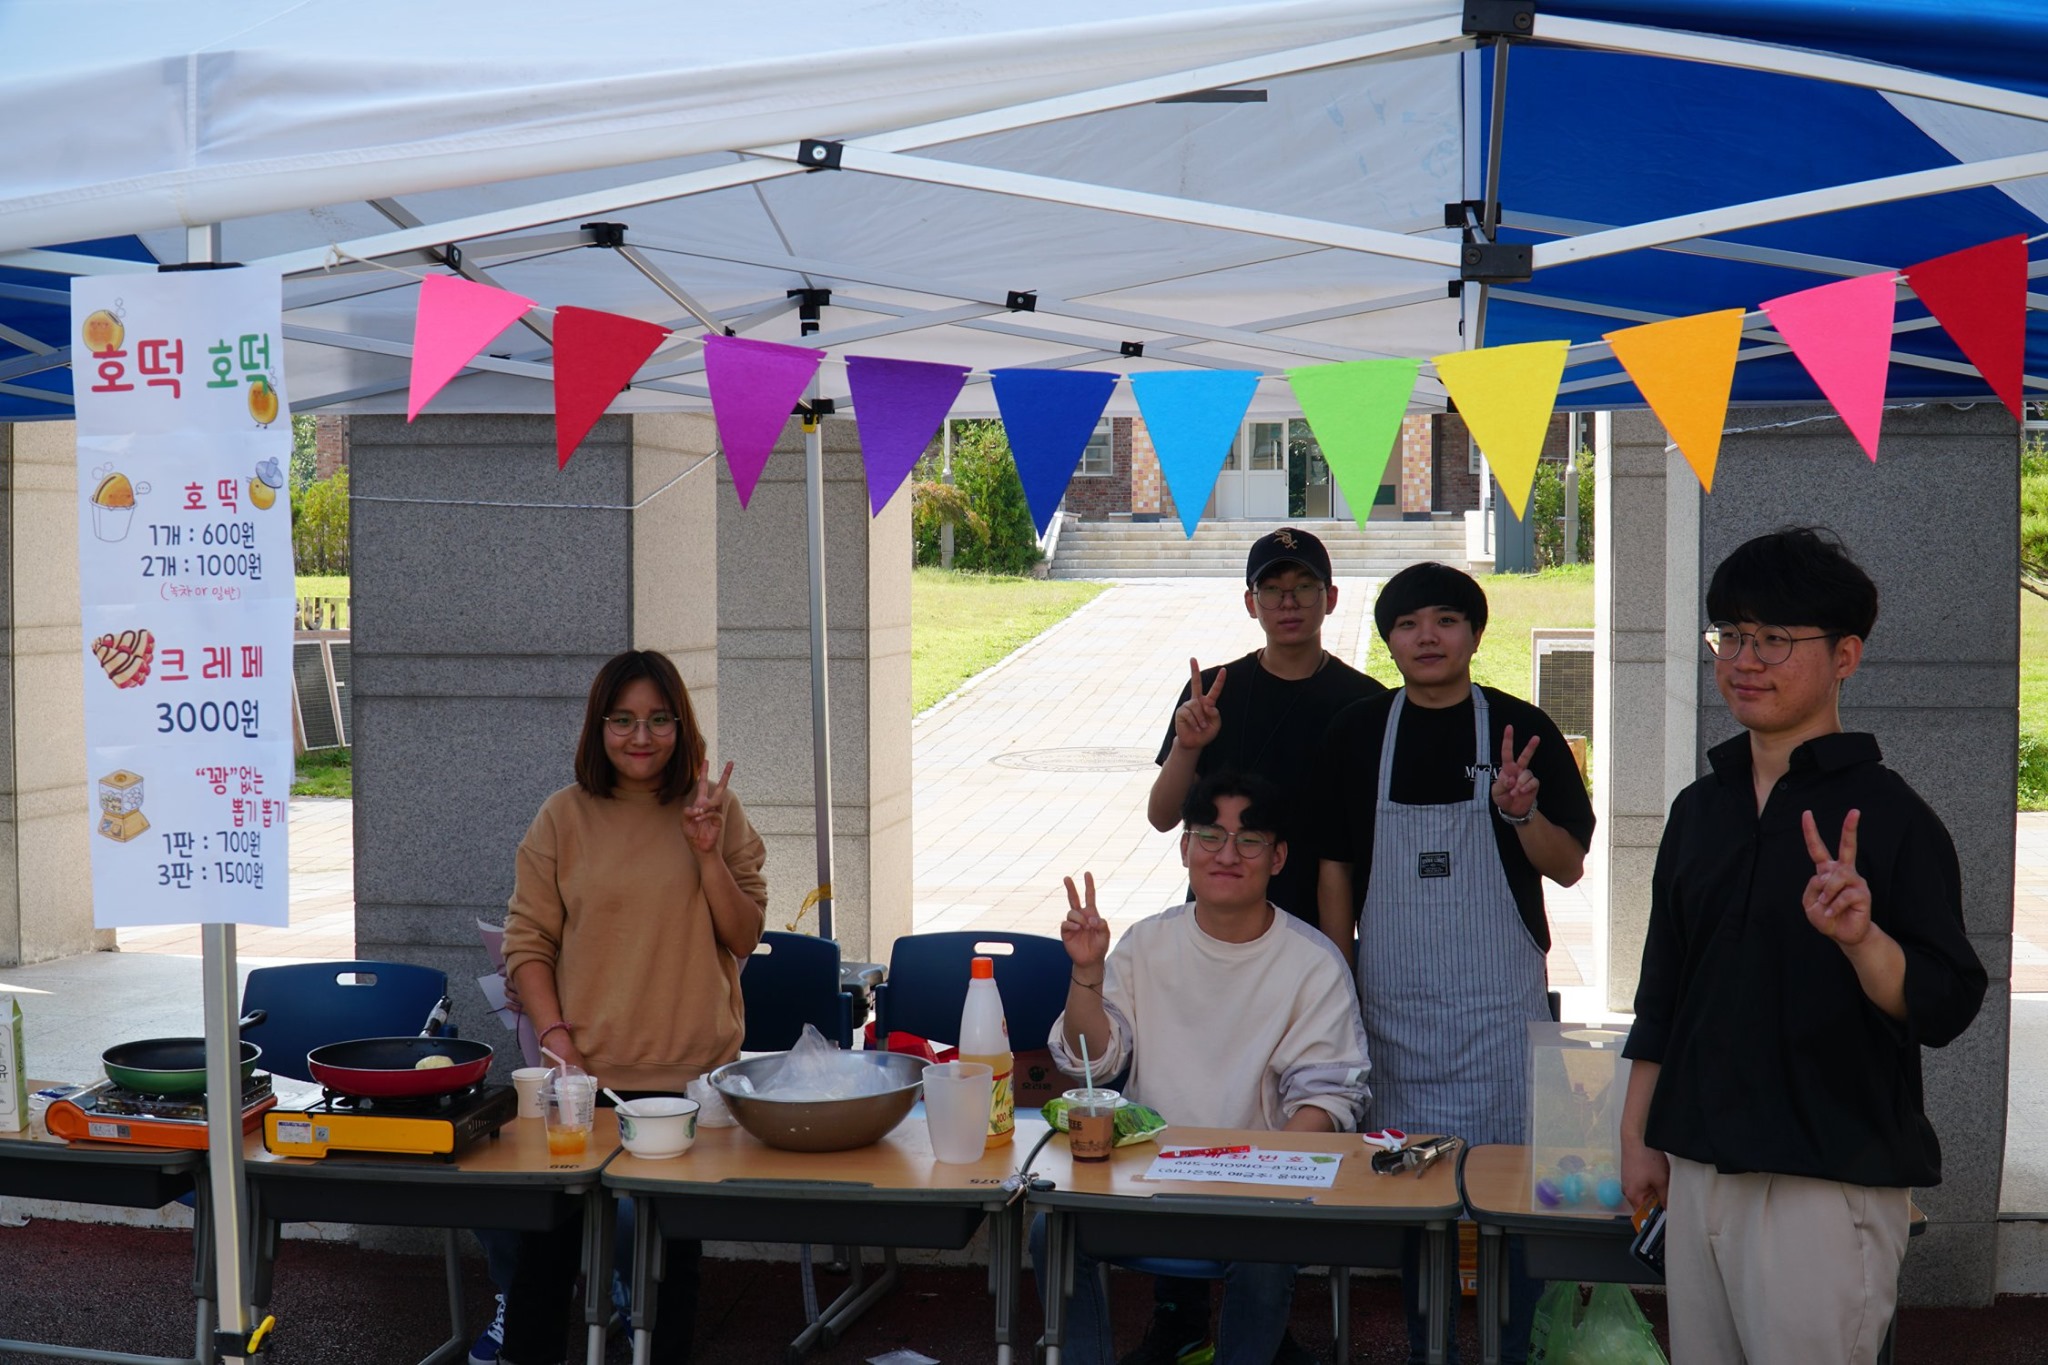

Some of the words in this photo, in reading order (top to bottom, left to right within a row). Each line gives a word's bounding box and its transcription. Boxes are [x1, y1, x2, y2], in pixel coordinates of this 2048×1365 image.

[91, 338, 183, 399] 호떡
[206, 332, 270, 396] 호떡
[202, 521, 255, 549] 600원
[196, 552, 262, 580] 1000원
[294, 596, 350, 631] UT
[156, 699, 260, 739] 3000원
[231, 797, 257, 828] 뽑기
[261, 797, 286, 829] 뽑기
[215, 830, 262, 858] 700원
[213, 861, 264, 890] 1500원
